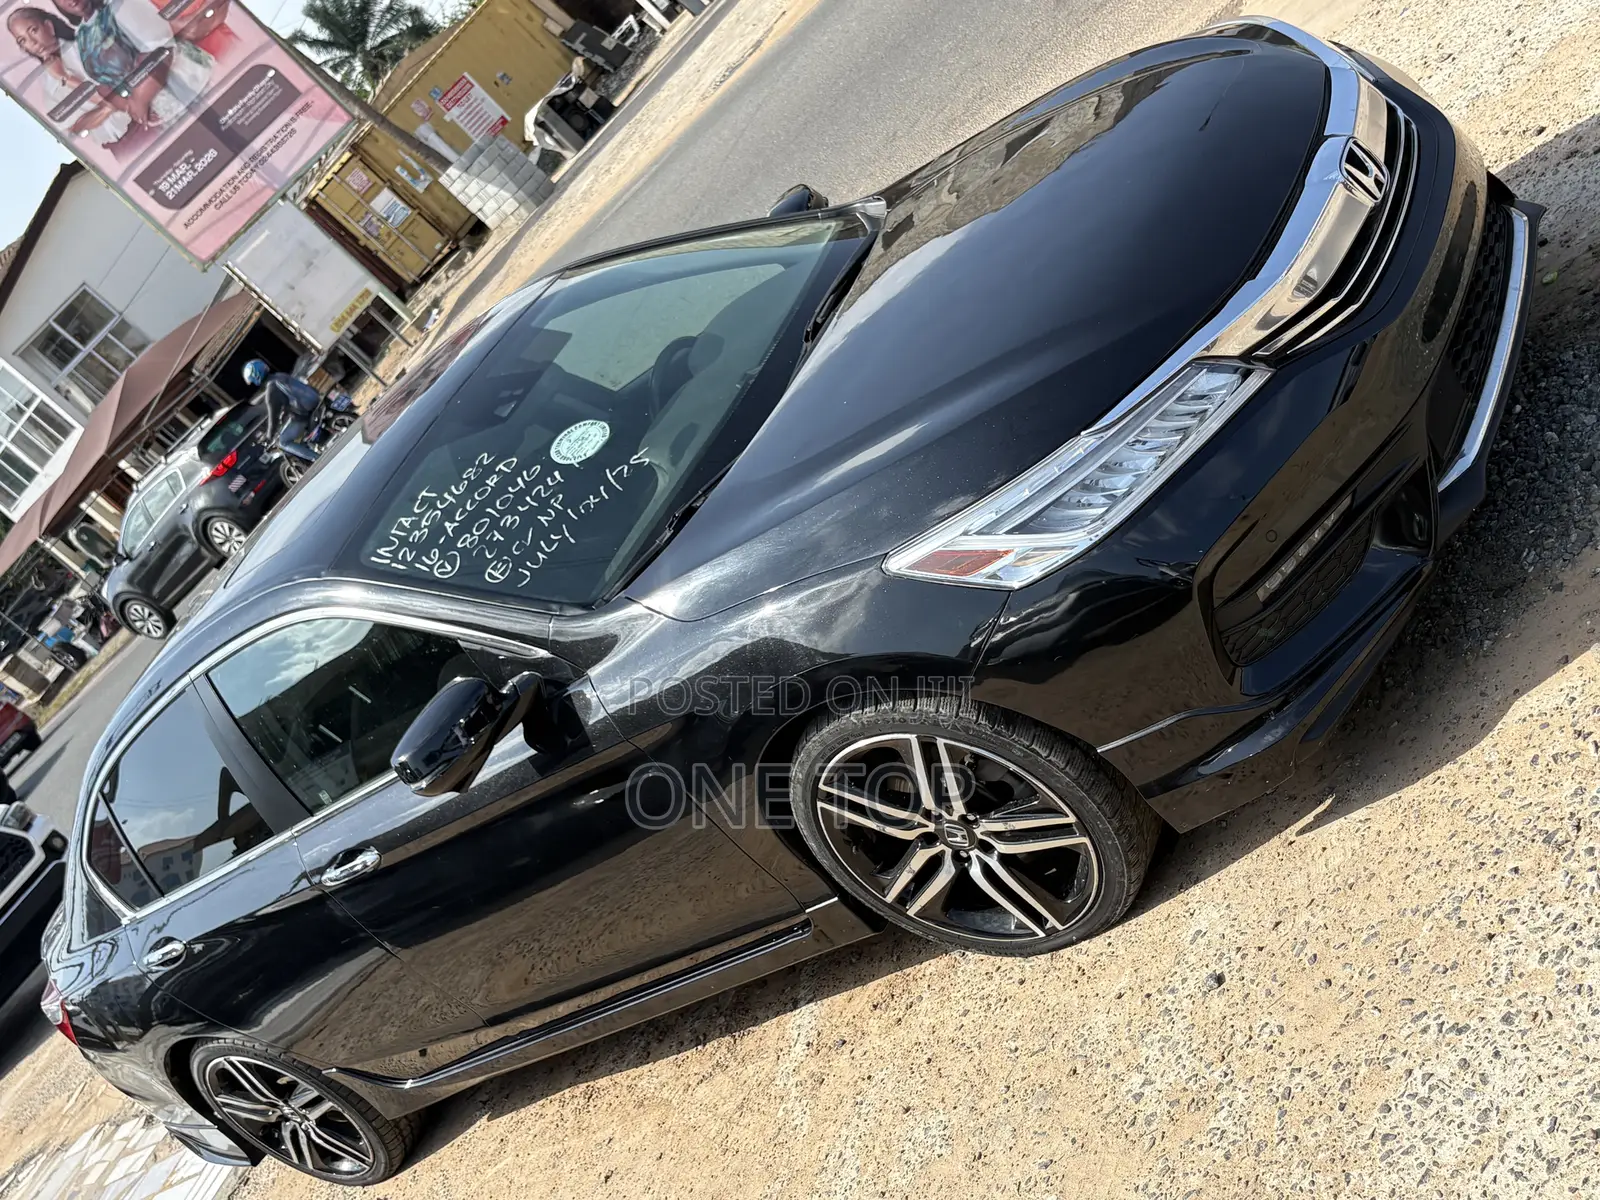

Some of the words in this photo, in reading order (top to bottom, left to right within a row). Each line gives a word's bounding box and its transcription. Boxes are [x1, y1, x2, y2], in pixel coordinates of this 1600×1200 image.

[236, 160, 250, 176] AND
[248, 121, 291, 162] REGISTRATION
[165, 187, 178, 200] 21
[213, 191, 232, 210] CALL
[230, 183, 240, 194] US
[371, 485, 438, 565] INTACT
[391, 452, 496, 570] 12354682
[457, 464, 541, 549] 801046
[473, 470, 564, 559] 273424
[537, 493, 564, 526] NP
